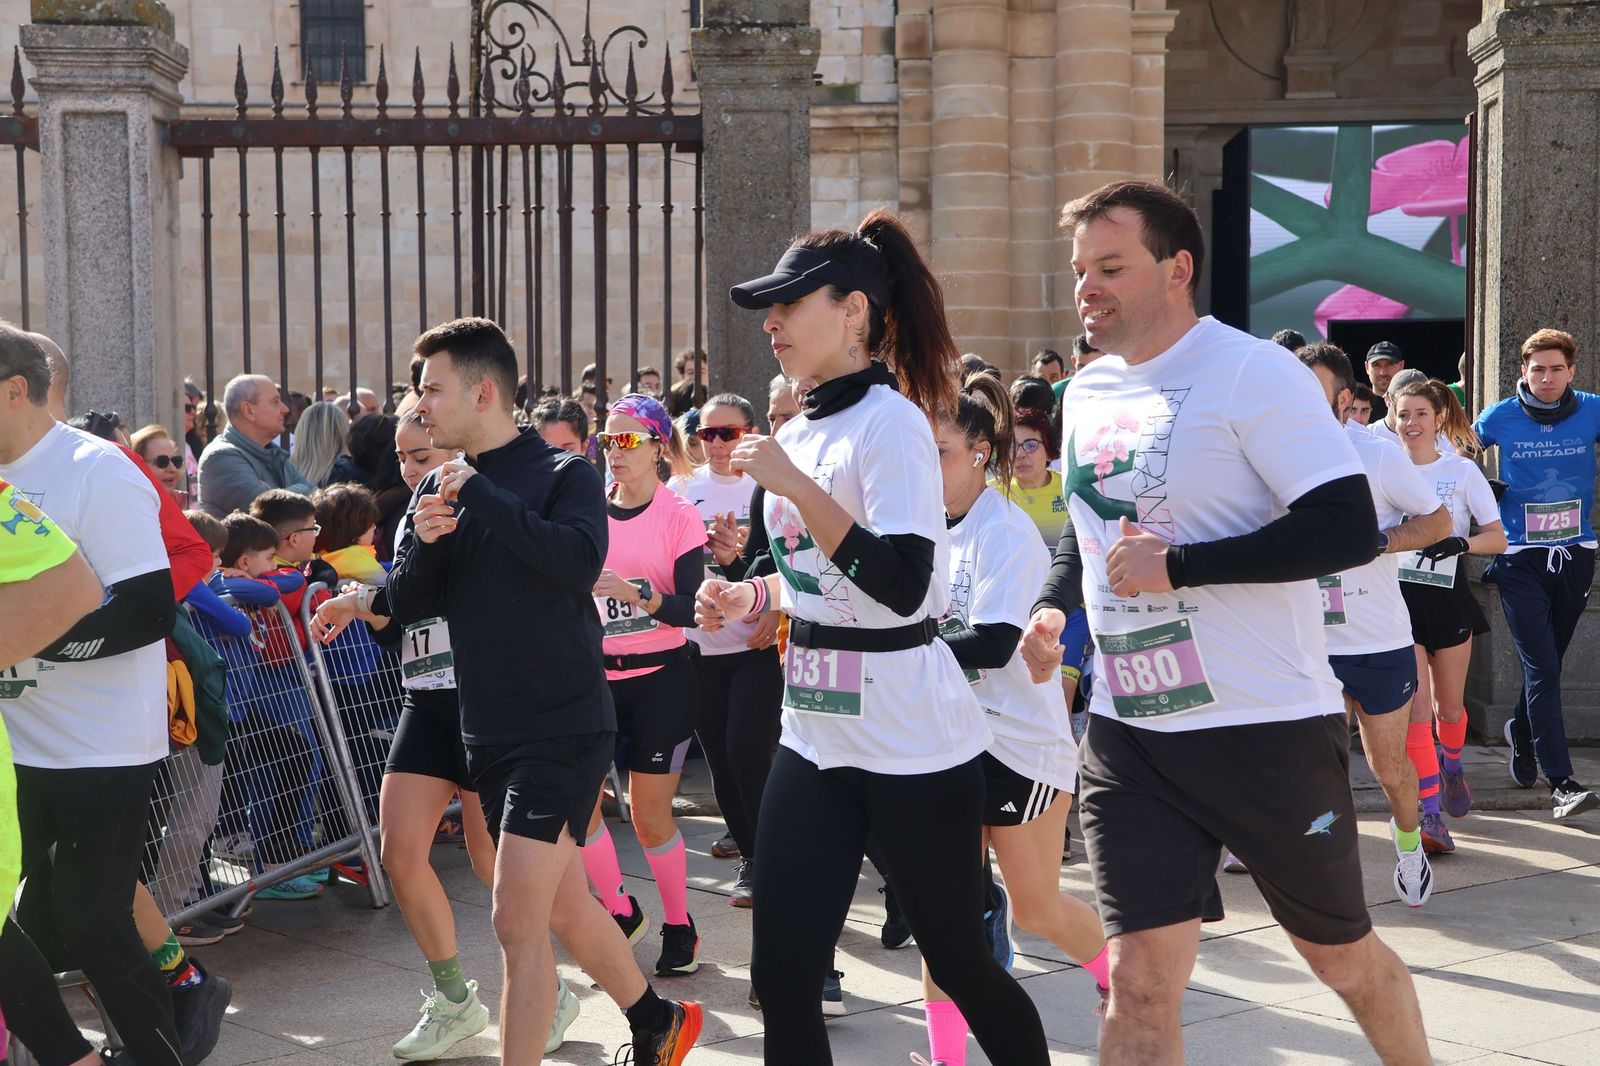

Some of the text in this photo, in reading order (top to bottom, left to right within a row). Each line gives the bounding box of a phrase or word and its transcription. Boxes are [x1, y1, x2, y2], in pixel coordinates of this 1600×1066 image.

[1511, 446, 1587, 459] AMIZADE
[1513, 438, 1583, 449] TRAIL DA
[1536, 511, 1571, 531] 725
[606, 597, 632, 620] 85
[411, 628, 430, 657] 17
[792, 646, 838, 688] 531
[1114, 648, 1182, 693] 680
